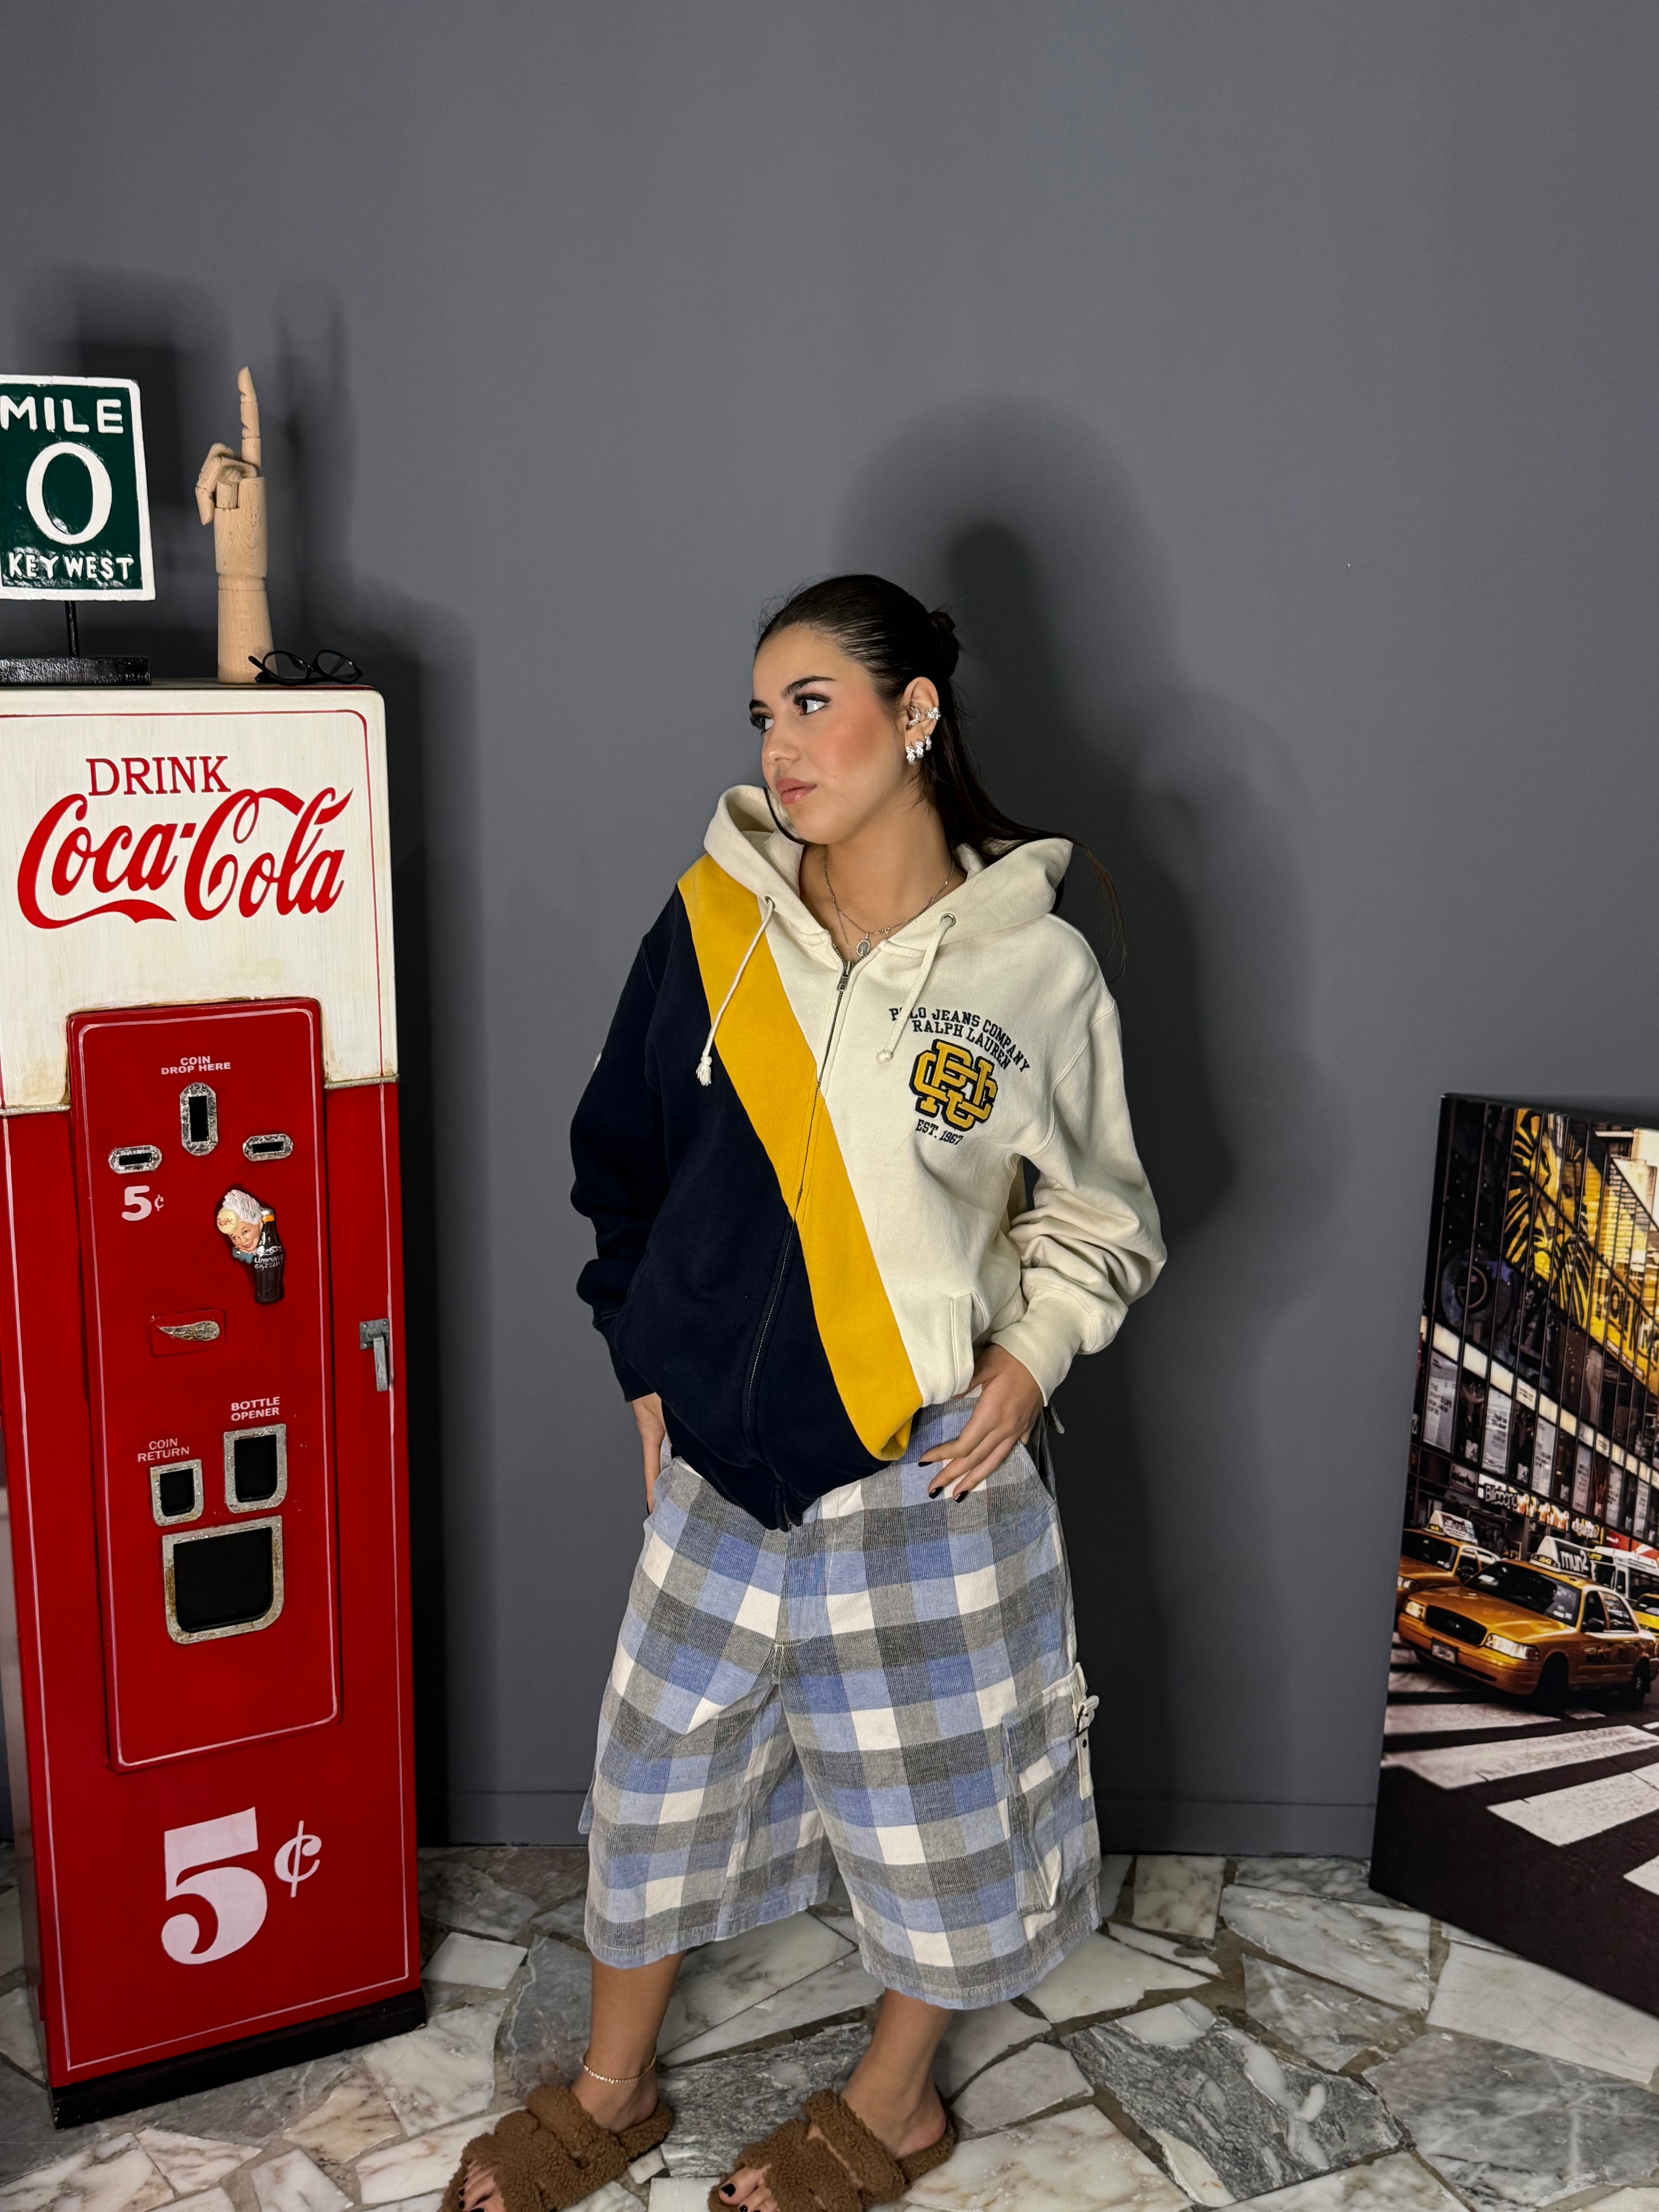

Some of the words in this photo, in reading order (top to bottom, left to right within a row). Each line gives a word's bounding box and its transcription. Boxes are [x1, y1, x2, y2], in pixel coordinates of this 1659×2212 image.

[0, 395, 124, 433] MILE
[8, 552, 59, 579] KEY
[64, 555, 134, 580] WEST
[86, 756, 231, 796] DRINK
[17, 787, 353, 930] Coca-Cola
[889, 1007, 927, 1021] PLO
[931, 1008, 981, 1027] JEANS
[982, 1019, 1030, 1072] COMPANY
[912, 1020, 964, 1038] RALPH
[965, 1027, 1011, 1071] LAUREN
[161, 1064, 195, 1075] DROP
[198, 1062, 231, 1072] HERE
[180, 1055, 211, 1066] COIN
[915, 1119, 939, 1139] EST.
[939, 1129, 964, 1145] 1967
[231, 1396, 280, 1412] BOTTLE
[231, 1407, 280, 1422] OPENER
[137, 1446, 190, 1463] RETURN
[148, 1437, 178, 1451] COIN
[1560, 1549, 1589, 1573] mun2
